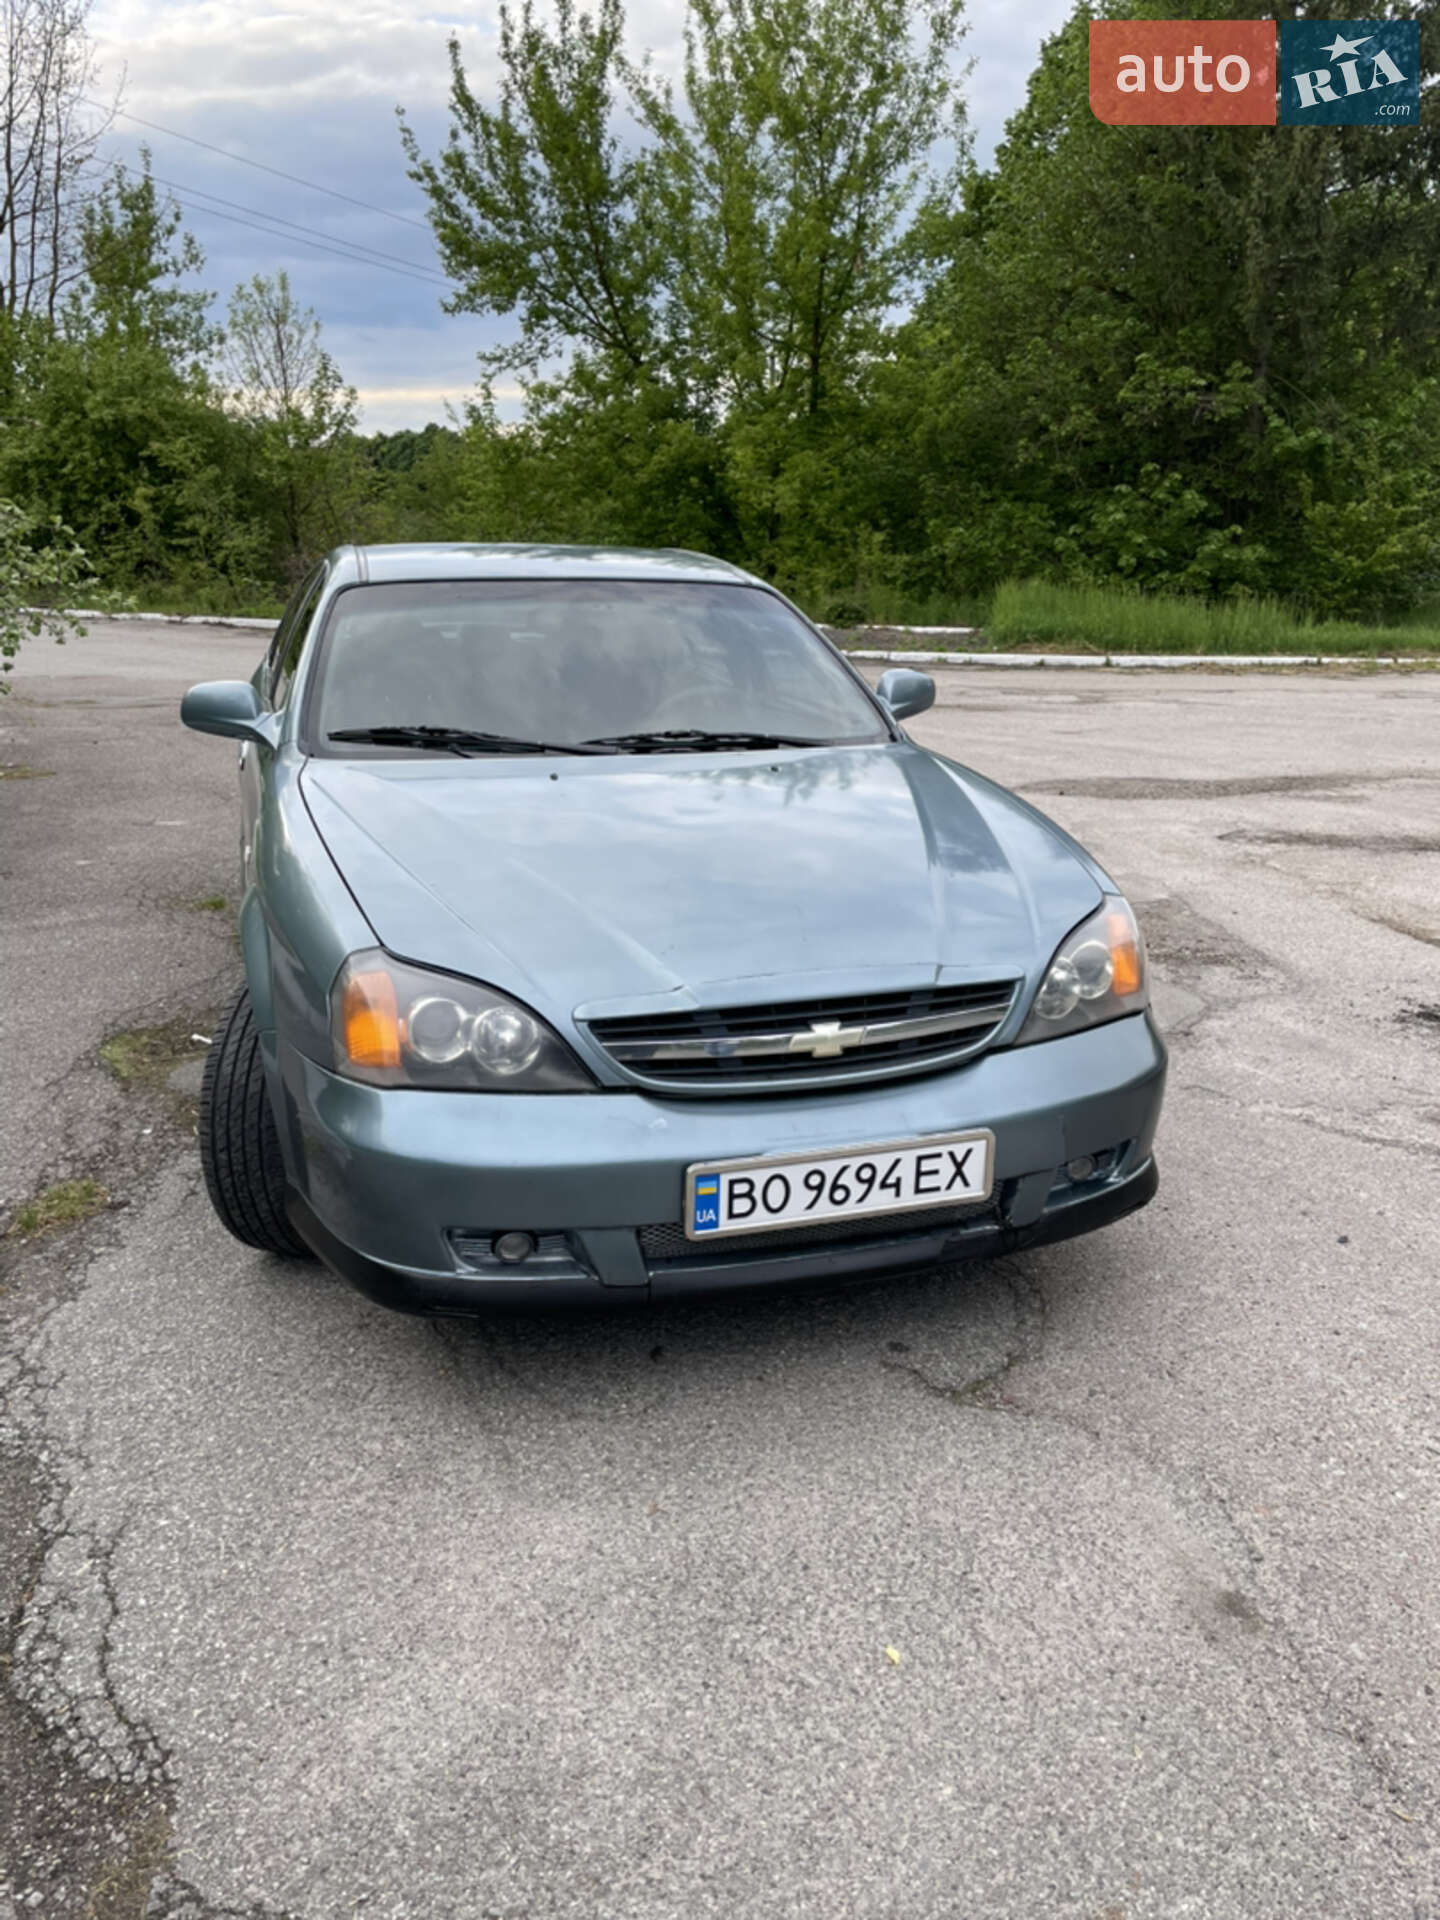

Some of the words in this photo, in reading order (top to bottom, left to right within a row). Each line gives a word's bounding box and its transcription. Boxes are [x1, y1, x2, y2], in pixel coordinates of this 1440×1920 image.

[727, 1173, 791, 1220] BO
[803, 1158, 903, 1211] 9694
[914, 1148, 974, 1195] EX
[696, 1209, 717, 1223] UA
